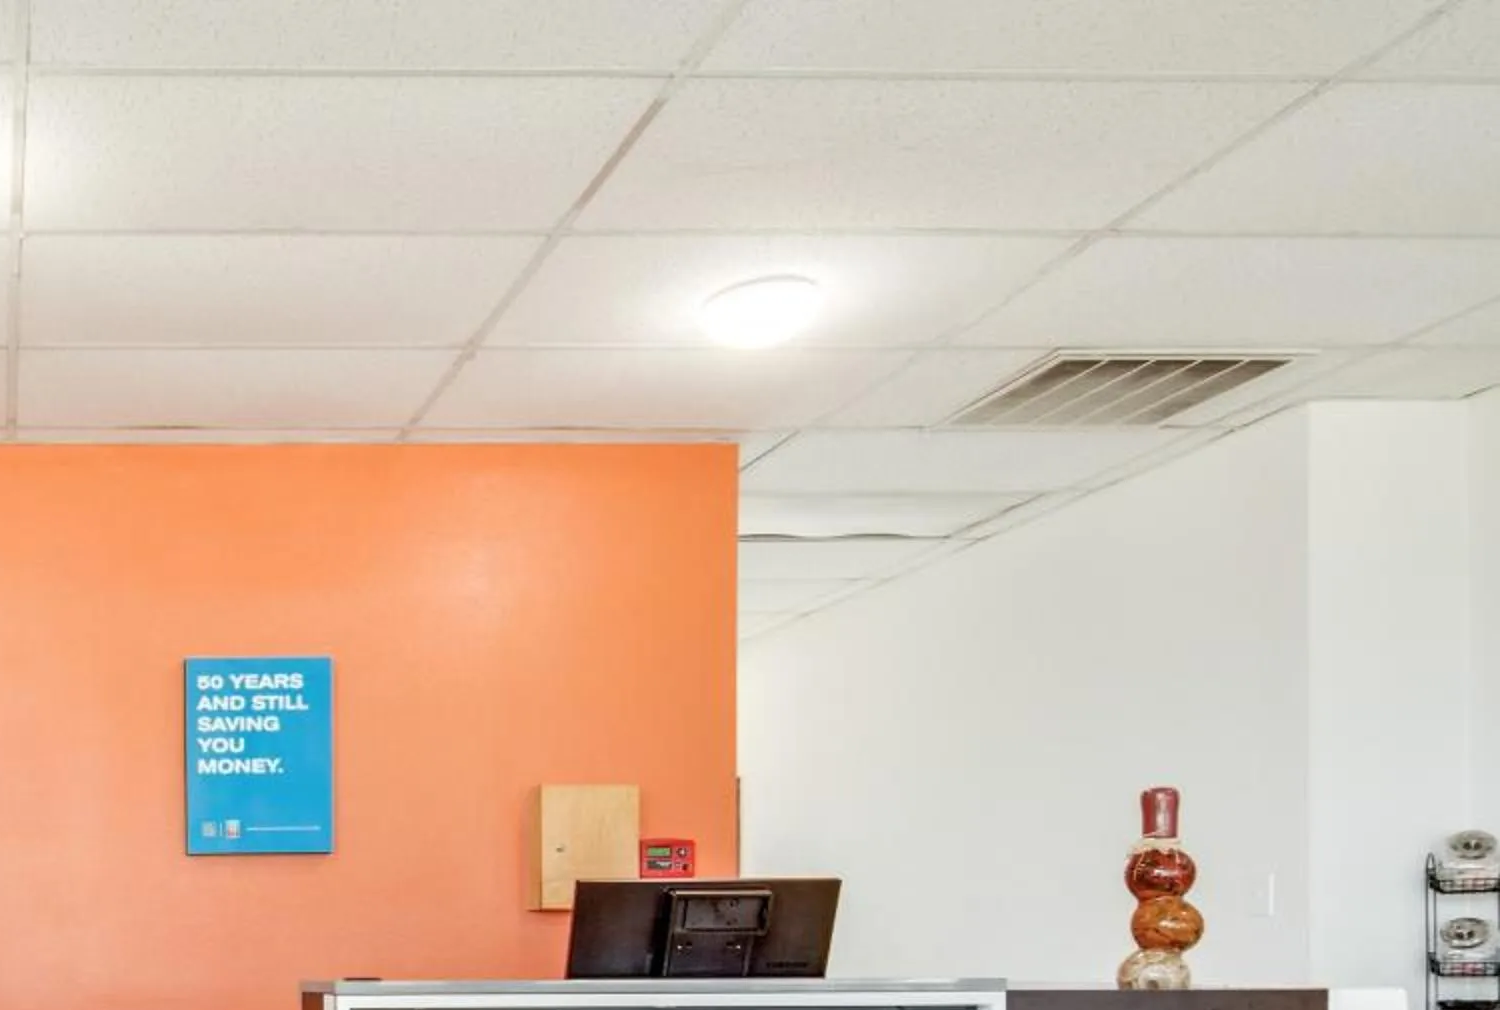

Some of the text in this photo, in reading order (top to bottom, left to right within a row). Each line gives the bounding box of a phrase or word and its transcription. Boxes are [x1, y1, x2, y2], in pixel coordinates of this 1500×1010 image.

[196, 672, 304, 690] 50 YEARS
[196, 693, 309, 711] AND STILL
[197, 715, 281, 732] SAVING
[196, 737, 245, 753] YOU
[197, 757, 284, 775] MONEY.
